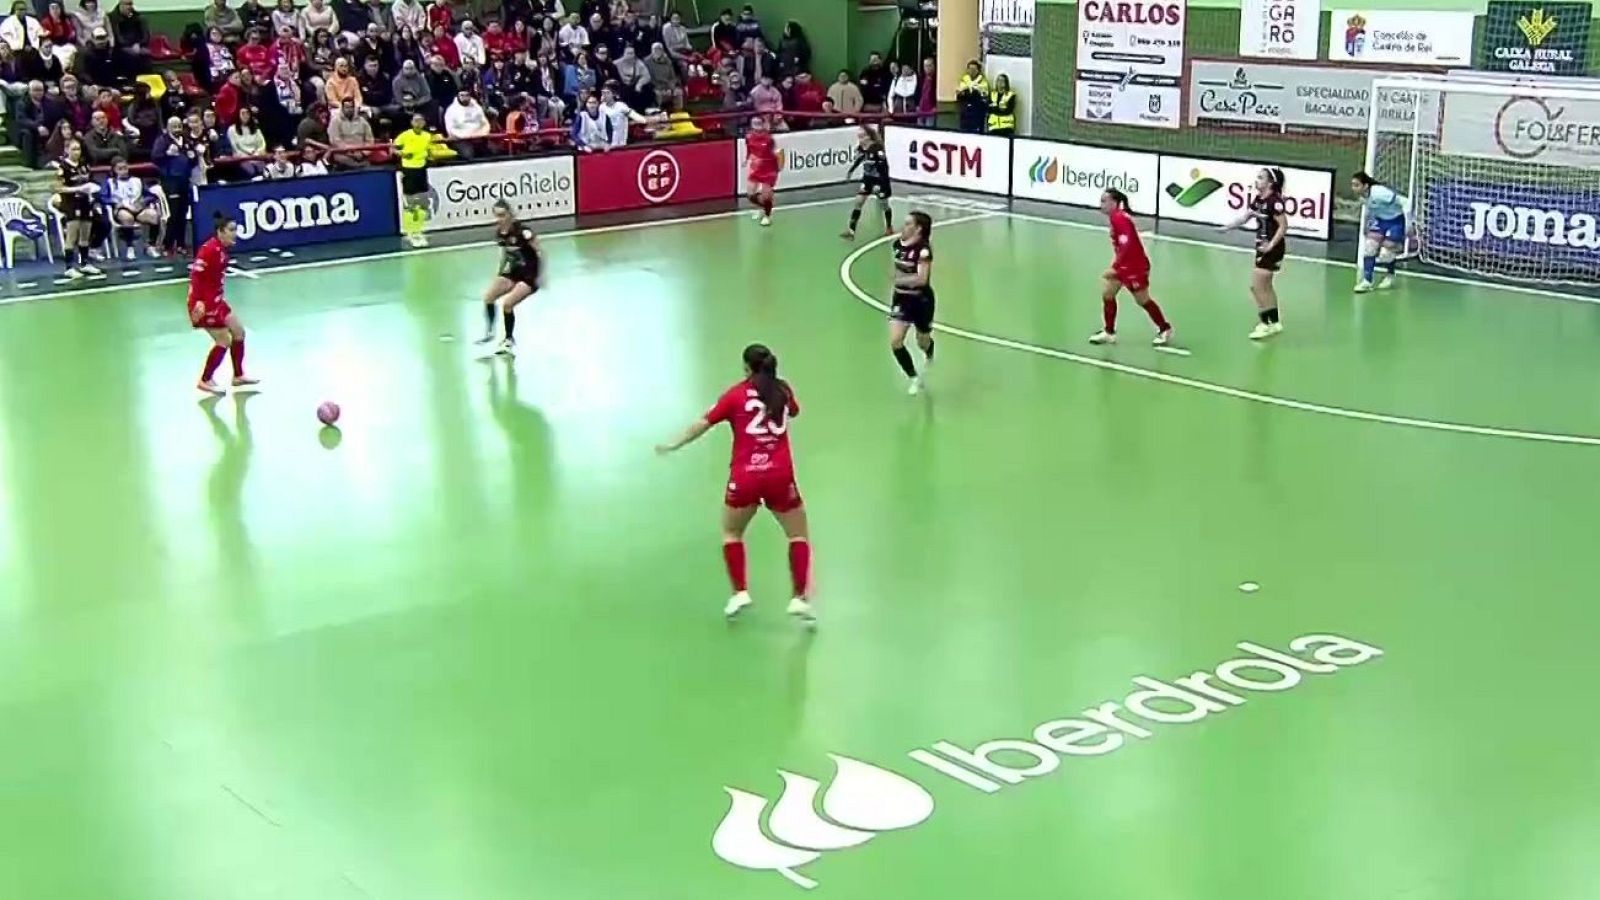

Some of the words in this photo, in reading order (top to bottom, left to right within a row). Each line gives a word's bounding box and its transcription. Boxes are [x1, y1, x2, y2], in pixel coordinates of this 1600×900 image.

[1084, 1, 1180, 25] CARLOS
[1494, 47, 1531, 60] CAIXA
[1534, 48, 1573, 61] RURAL
[1508, 60, 1556, 72] GALEGA
[1296, 86, 1369, 101] ESPECIALIDAD
[921, 141, 983, 178] STM
[1062, 163, 1140, 193] Iberdrola
[907, 633, 1385, 794] Iberdrola
